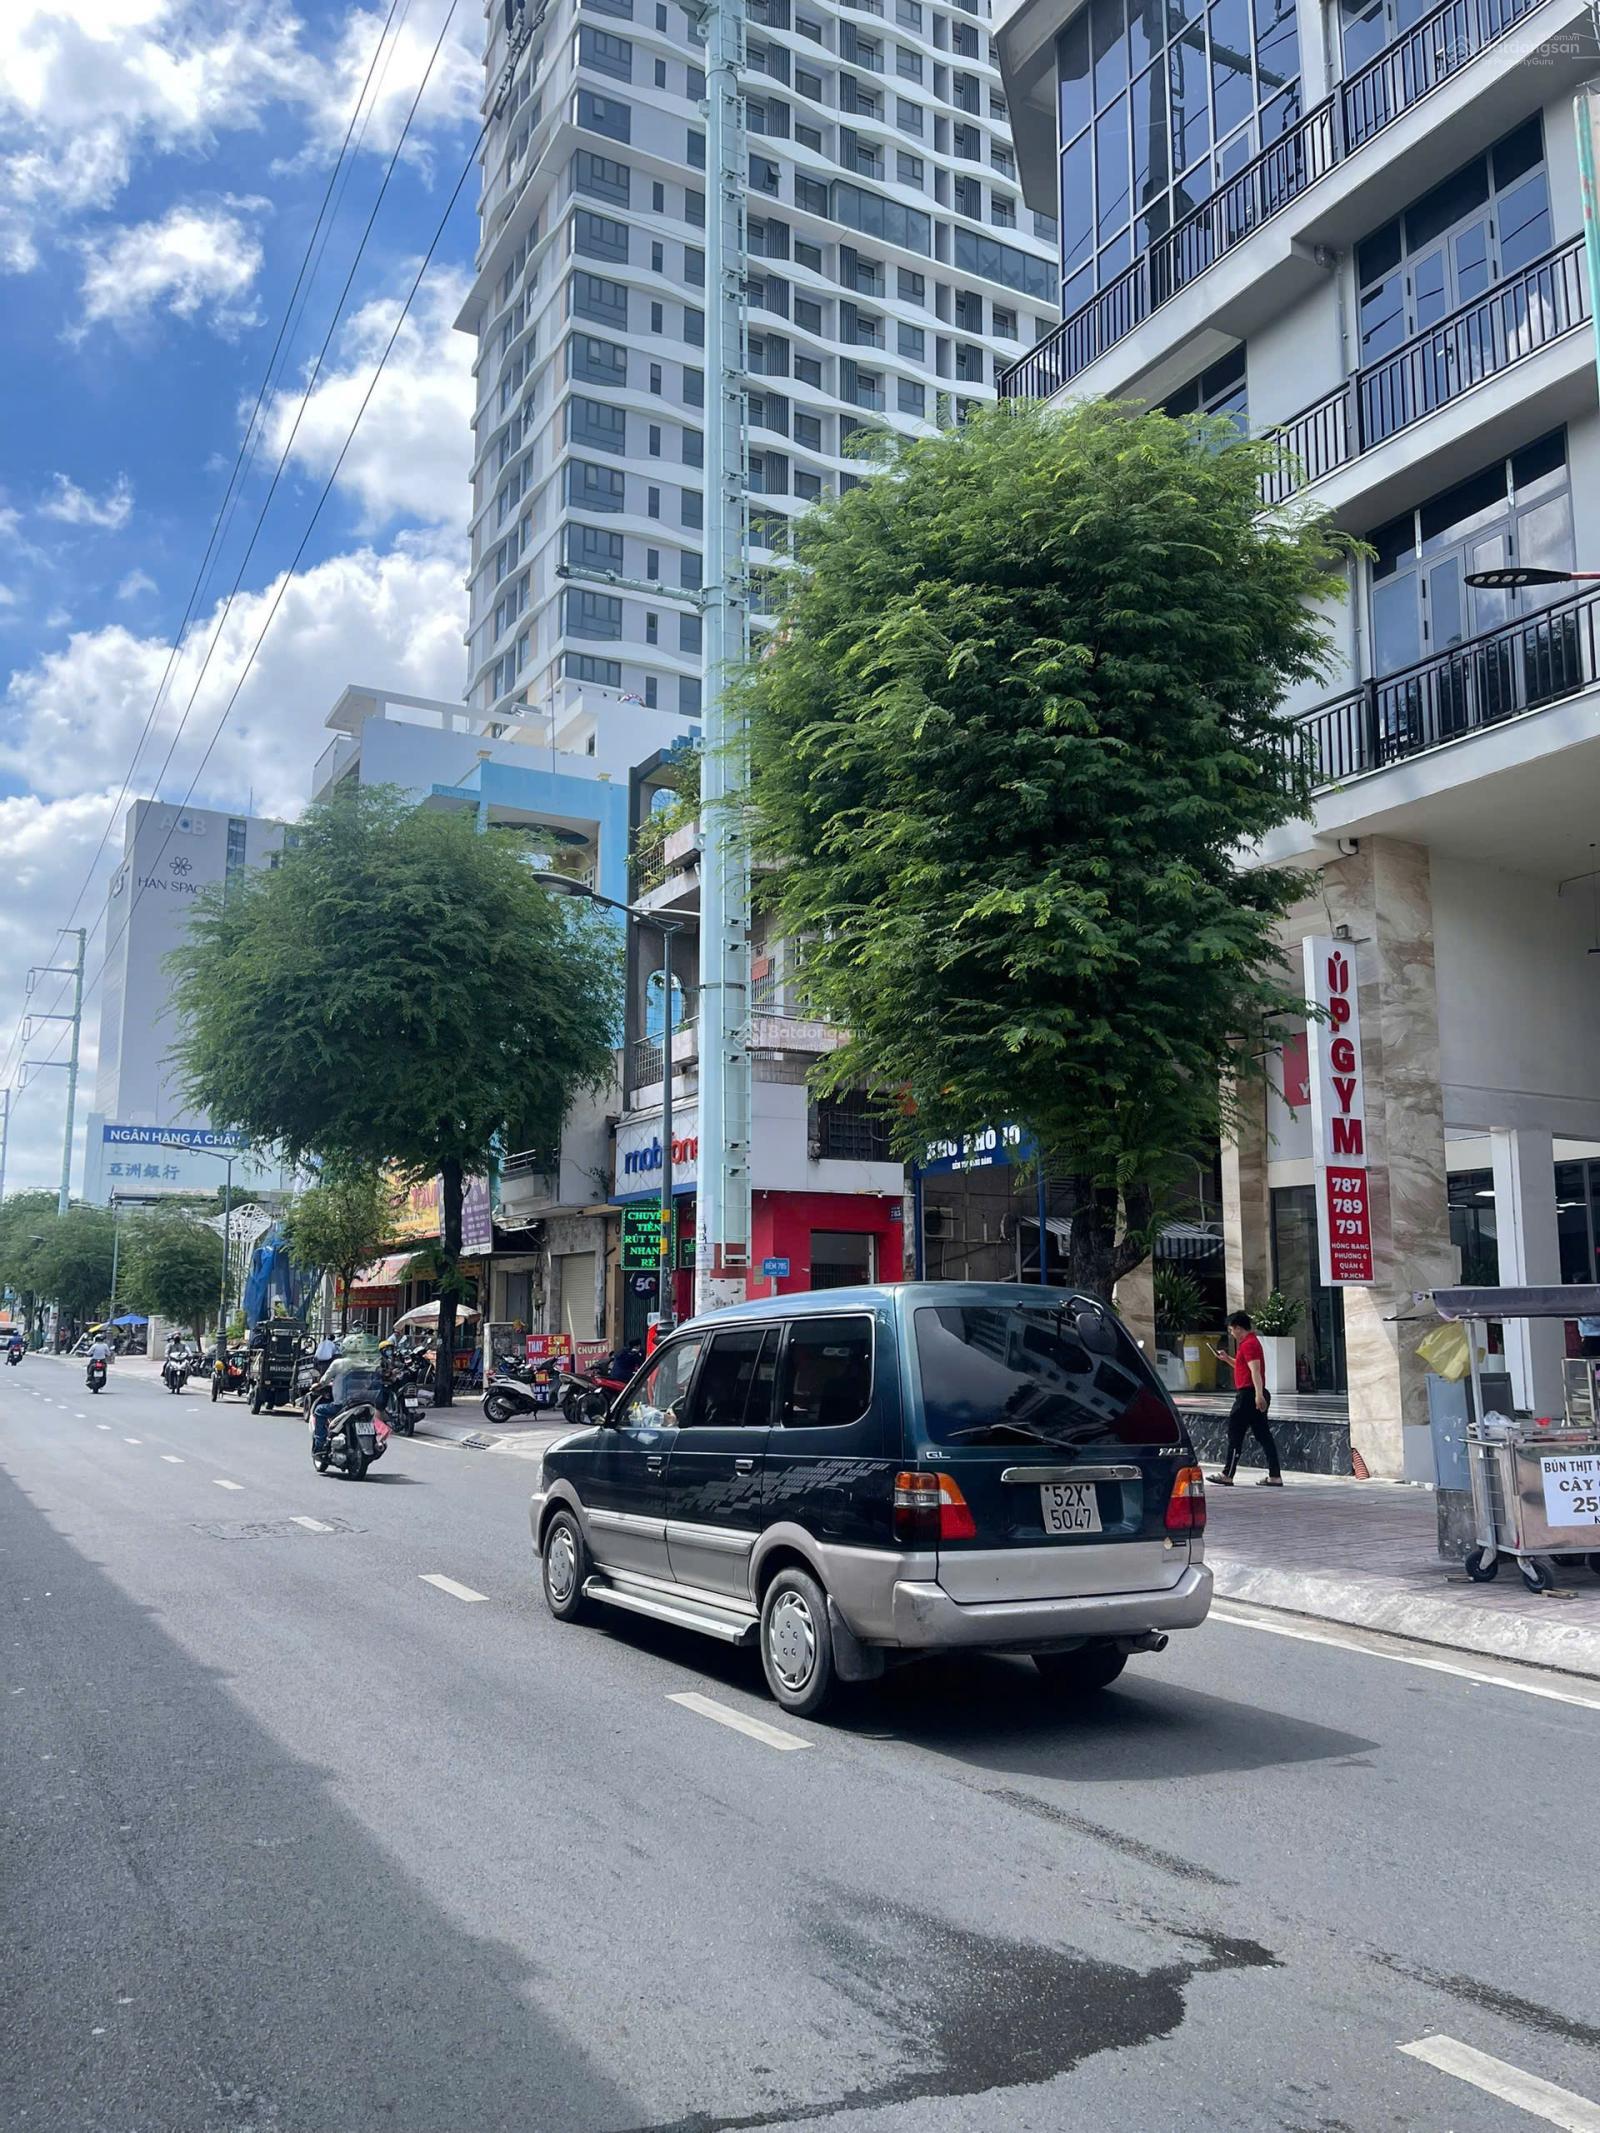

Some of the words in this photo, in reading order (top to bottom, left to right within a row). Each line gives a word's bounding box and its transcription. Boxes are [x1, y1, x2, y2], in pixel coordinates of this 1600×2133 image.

[138, 877, 167, 890] HAN
[110, 1129, 149, 1141] NGÂN
[193, 1132, 202, 1145] Á
[1332, 1178, 1361, 1193] 787
[1333, 1199, 1363, 1214] 789
[627, 1211, 662, 1220] CHUY
[1336, 1219, 1362, 1235] 791
[625, 1233, 647, 1243] RÚT
[630, 1246, 662, 1255] NHAN
[528, 1341, 543, 1353] THAY
[926, 1451, 951, 1459] GL
[1544, 1459, 1567, 1473] BÚN
[1569, 1460, 1592, 1474] THỊT
[1559, 1476, 1594, 1492] CÂY
[1053, 1485, 1085, 1507] 52X
[1573, 1496, 1600, 1513] 25
[1051, 1508, 1091, 1530] 5047
